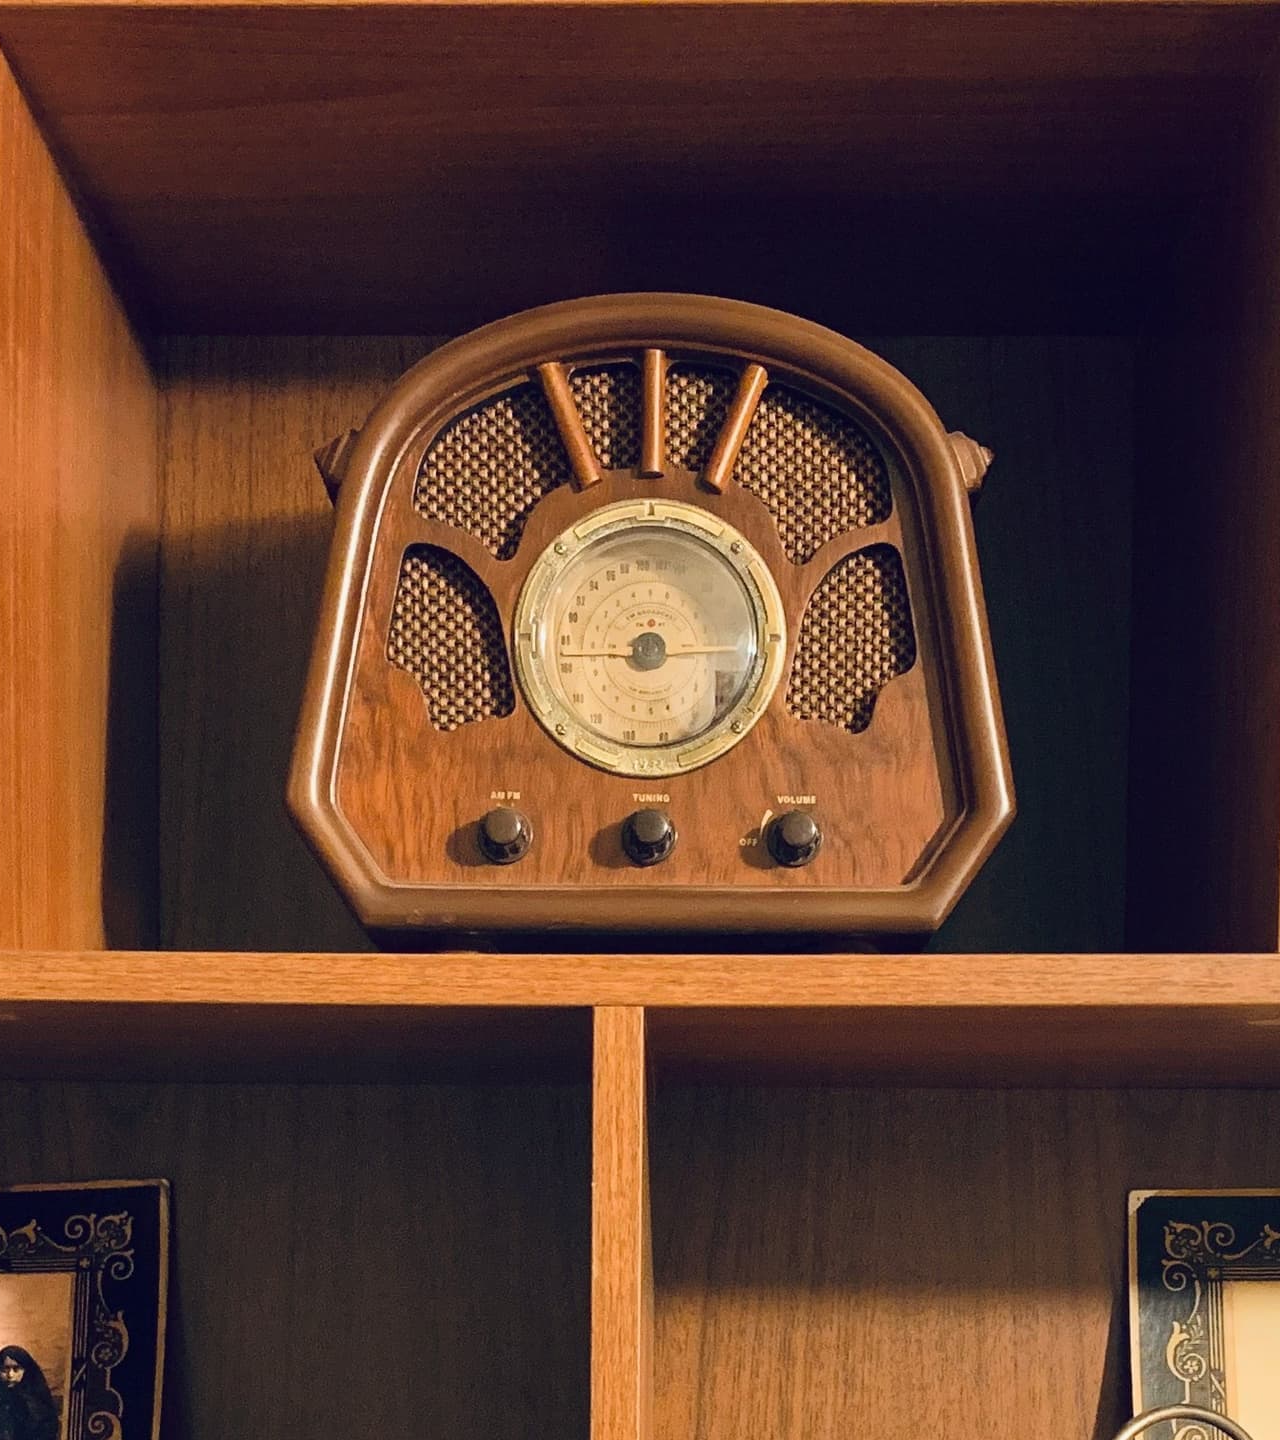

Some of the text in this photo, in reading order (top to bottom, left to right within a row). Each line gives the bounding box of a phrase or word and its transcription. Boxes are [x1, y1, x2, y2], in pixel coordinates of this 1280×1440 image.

[490, 791, 521, 801] AM FM
[632, 793, 670, 803] TUNING
[777, 795, 817, 805] VOLUME
[739, 838, 758, 847] OFF
